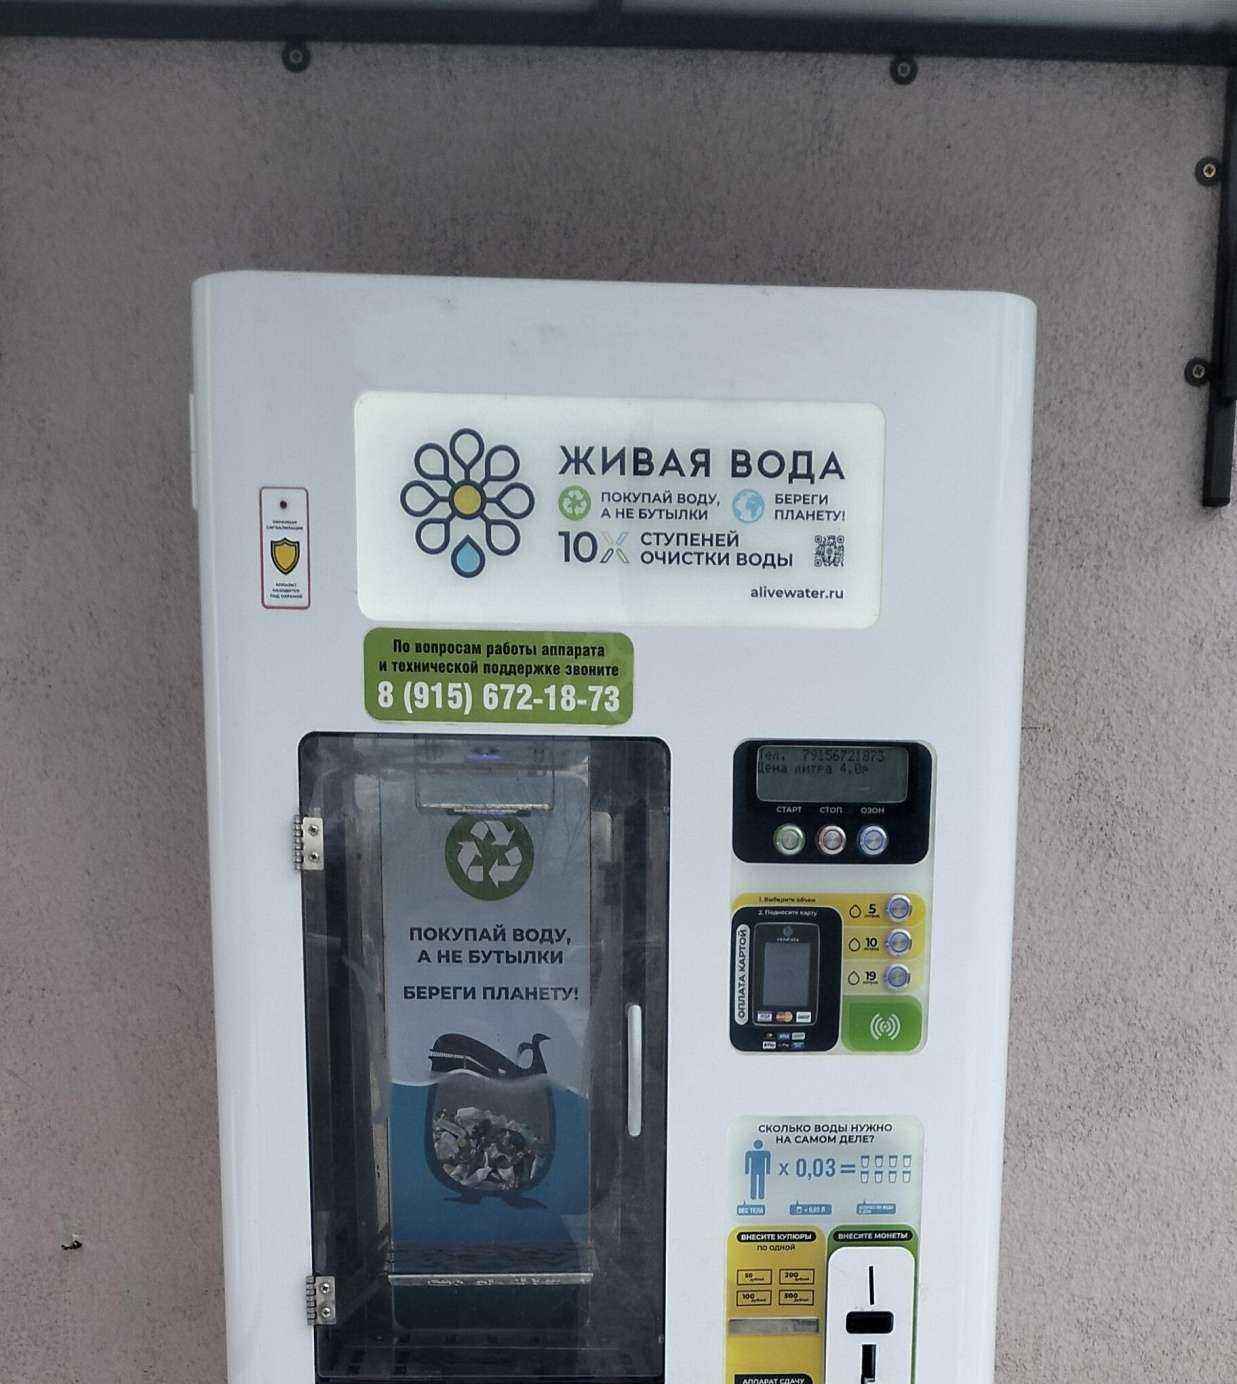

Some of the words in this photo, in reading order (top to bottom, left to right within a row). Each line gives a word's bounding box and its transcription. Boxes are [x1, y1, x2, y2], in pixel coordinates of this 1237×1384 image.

[558, 445, 711, 478] ЖИВАЯ
[731, 449, 845, 484] ВОДА
[601, 489, 673, 505] ПОКУПАЙ
[677, 493, 720, 507] ВОДУ,
[774, 493, 829, 506] БЕРЕГИ
[601, 508, 611, 520] А
[615, 508, 635, 520] НЕ
[638, 509, 709, 521] БУТЫЛКИ
[774, 509, 846, 522] ПЛАНЕТУ!
[641, 530, 740, 548] СТУПЕНЕЙ
[641, 552, 730, 567] ОЧИСТКИ
[736, 553, 793, 569] ВОДЫ
[750, 586, 844, 600] alivewater.ru
[393, 639, 410, 654] По
[415, 641, 482, 657] вопросам
[486, 642, 537, 658] работы
[542, 644, 605, 659] аппарата
[379, 662, 387, 672] и
[392, 660, 479, 674] технической
[483, 664, 561, 677] поддержке
[565, 664, 619, 677] звоните
[378, 681, 394, 709] 8
[403, 681, 473, 715] (915)
[483, 682, 620, 712] 672-18-73
[776, 806, 802, 814] СТАРТ
[868, 904, 877, 914] 5
[409, 924, 507, 942] ПОКУПАЙ
[512, 928, 572, 945] ВОДУ,
[866, 937, 878, 947] 10
[417, 949, 432, 963] А
[437, 950, 463, 963] НЕ
[468, 950, 563, 964] БУТЫЛКИ
[738, 929, 747, 972] КАРТОЙ
[866, 971, 877, 981] 19
[403, 985, 476, 1000] БЕРЕГИ
[482, 986, 579, 1001] ПЛАНЕТУ!
[758, 1124, 811, 1133] СКОЛЬКО
[814, 1124, 848, 1133] ВОДЫ
[850, 1123, 893, 1133] НУЖНО
[776, 1136, 792, 1144] НА
[794, 1135, 836, 1144] САМОМ
[839, 1135, 875, 1145] ДЕЛЕ?
[796, 1158, 836, 1180] 0,03
[741, 1233, 776, 1241] ВНЕСИТЕ
[838, 1232, 873, 1240] ВНЕСИТЕ
[874, 1232, 908, 1240] МОНЕТЫ
[769, 1243, 795, 1252] ОДНОЙ
